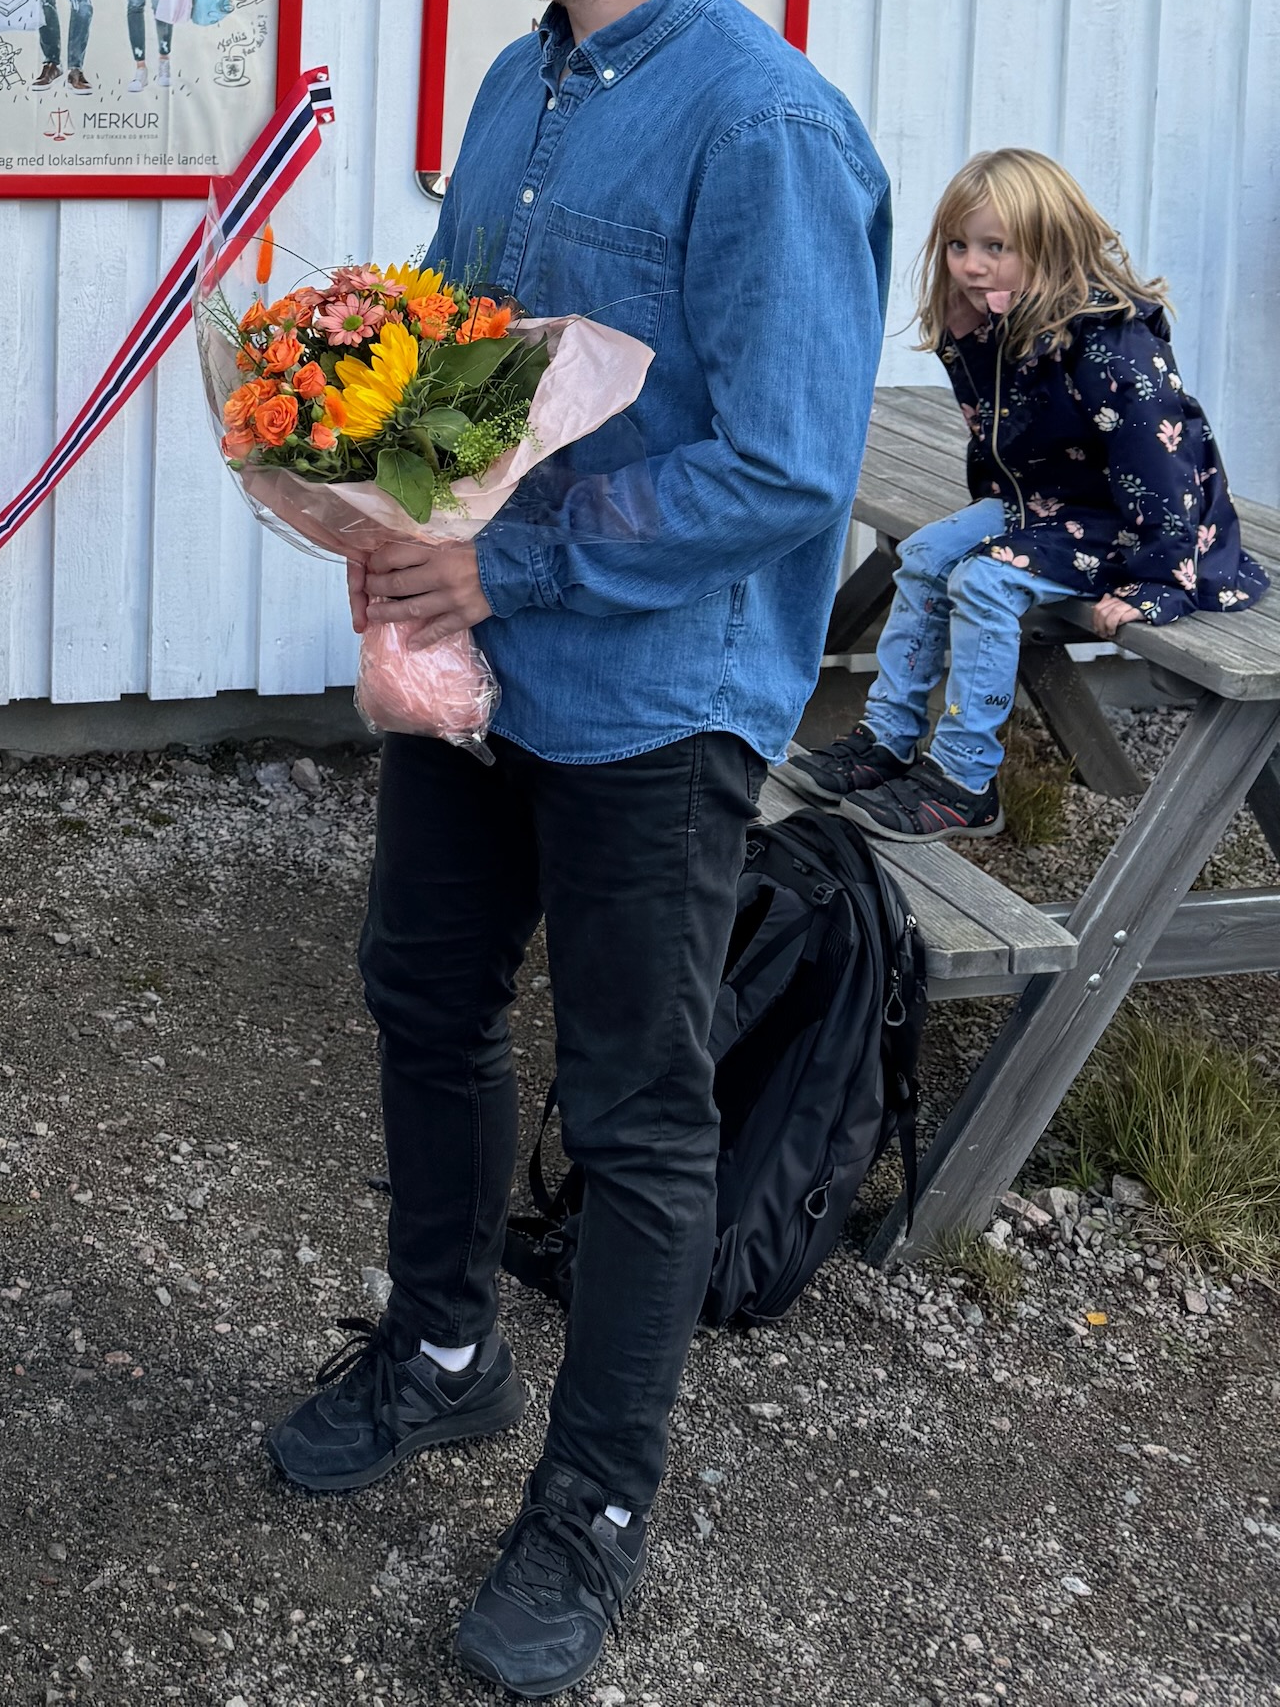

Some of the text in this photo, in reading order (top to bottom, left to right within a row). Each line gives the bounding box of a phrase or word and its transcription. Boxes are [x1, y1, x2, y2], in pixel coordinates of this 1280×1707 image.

[83, 112, 160, 129] MERKUR
[17, 154, 45, 166] med
[48, 153, 133, 166] lokalsamfunn
[136, 153, 140, 166] i
[143, 153, 174, 166] heile
[177, 153, 220, 166] landet.
[983, 693, 1012, 710] love
